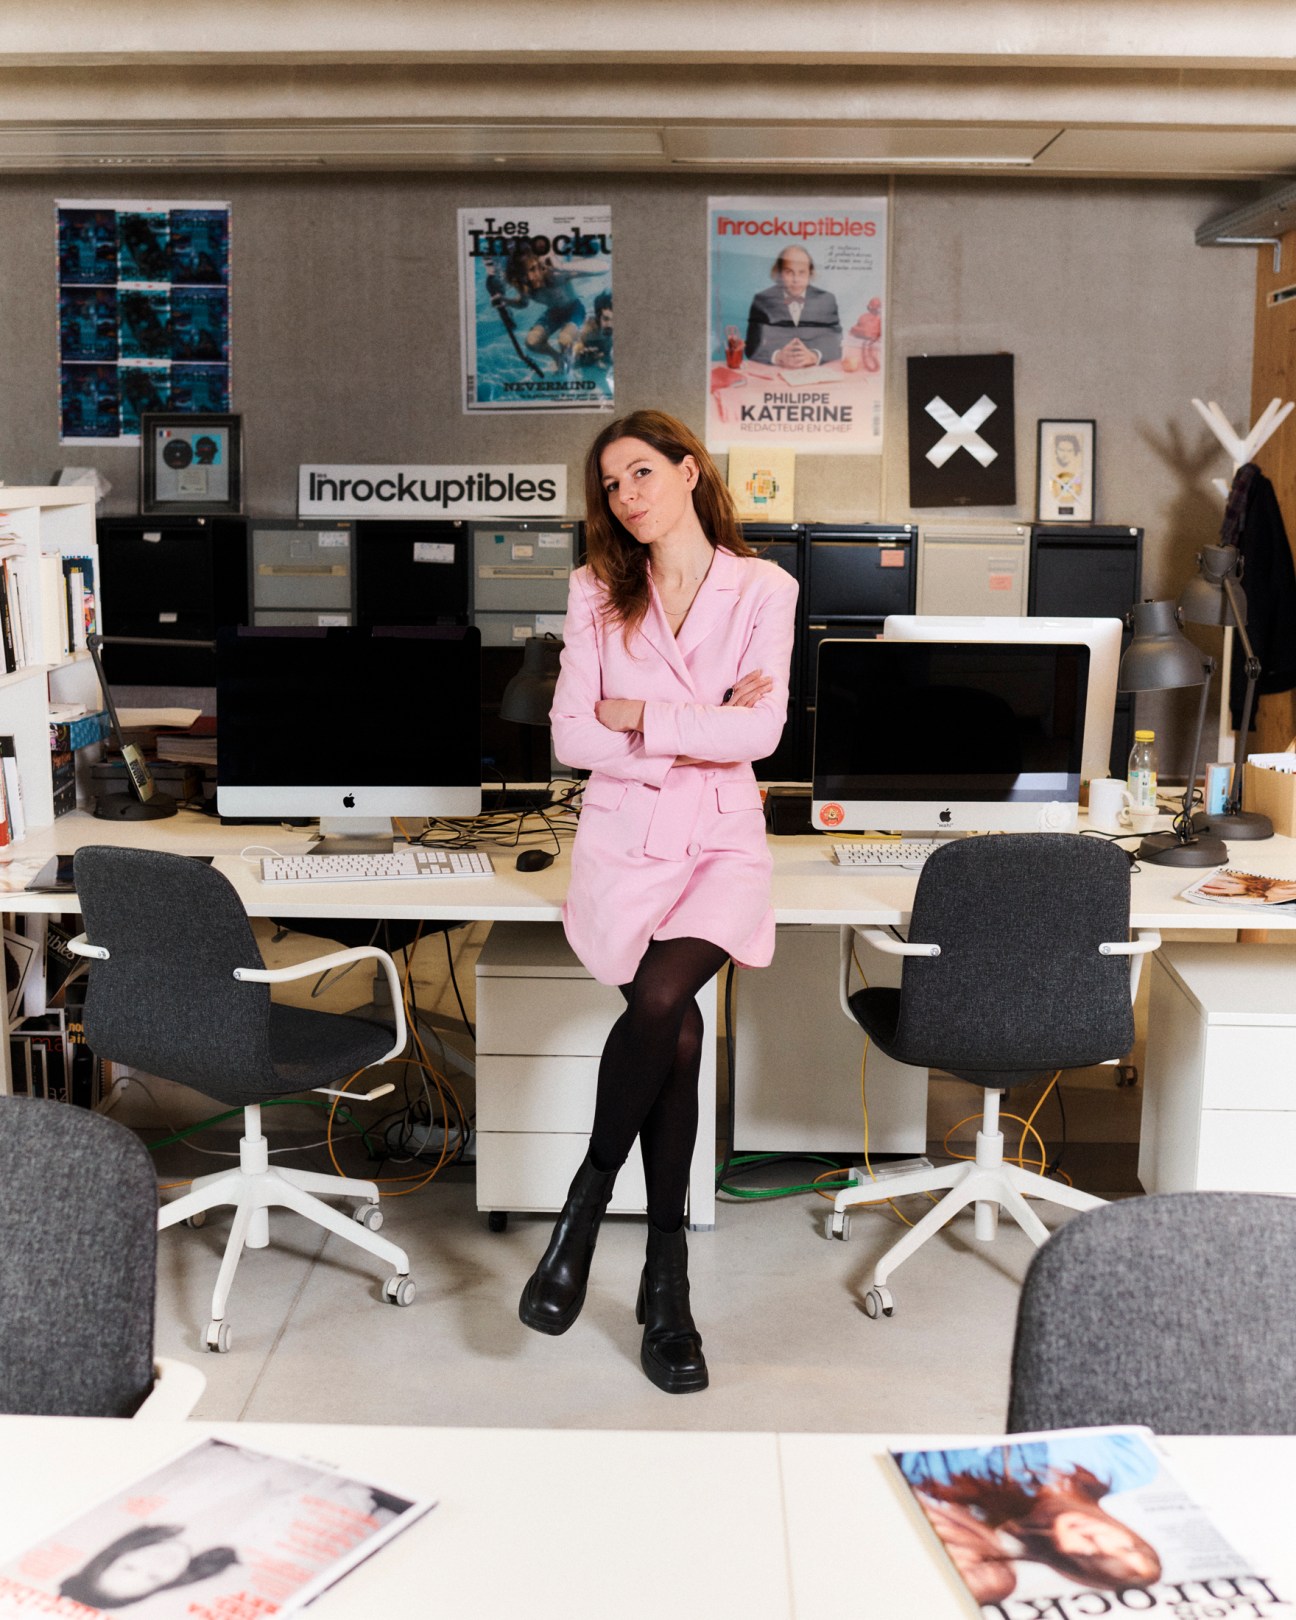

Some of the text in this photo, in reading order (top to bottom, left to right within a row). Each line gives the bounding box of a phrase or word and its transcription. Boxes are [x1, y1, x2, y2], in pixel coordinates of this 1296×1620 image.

[485, 218, 529, 235] Les
[717, 217, 877, 240] Inrockuptibles
[504, 381, 596, 392] NEVERMIND
[764, 393, 830, 404] PHILIPPE
[741, 405, 853, 422] KATERINE
[807, 424, 821, 432] EN
[823, 424, 852, 432] CHEF
[309, 472, 557, 509] Inrockuptibles
